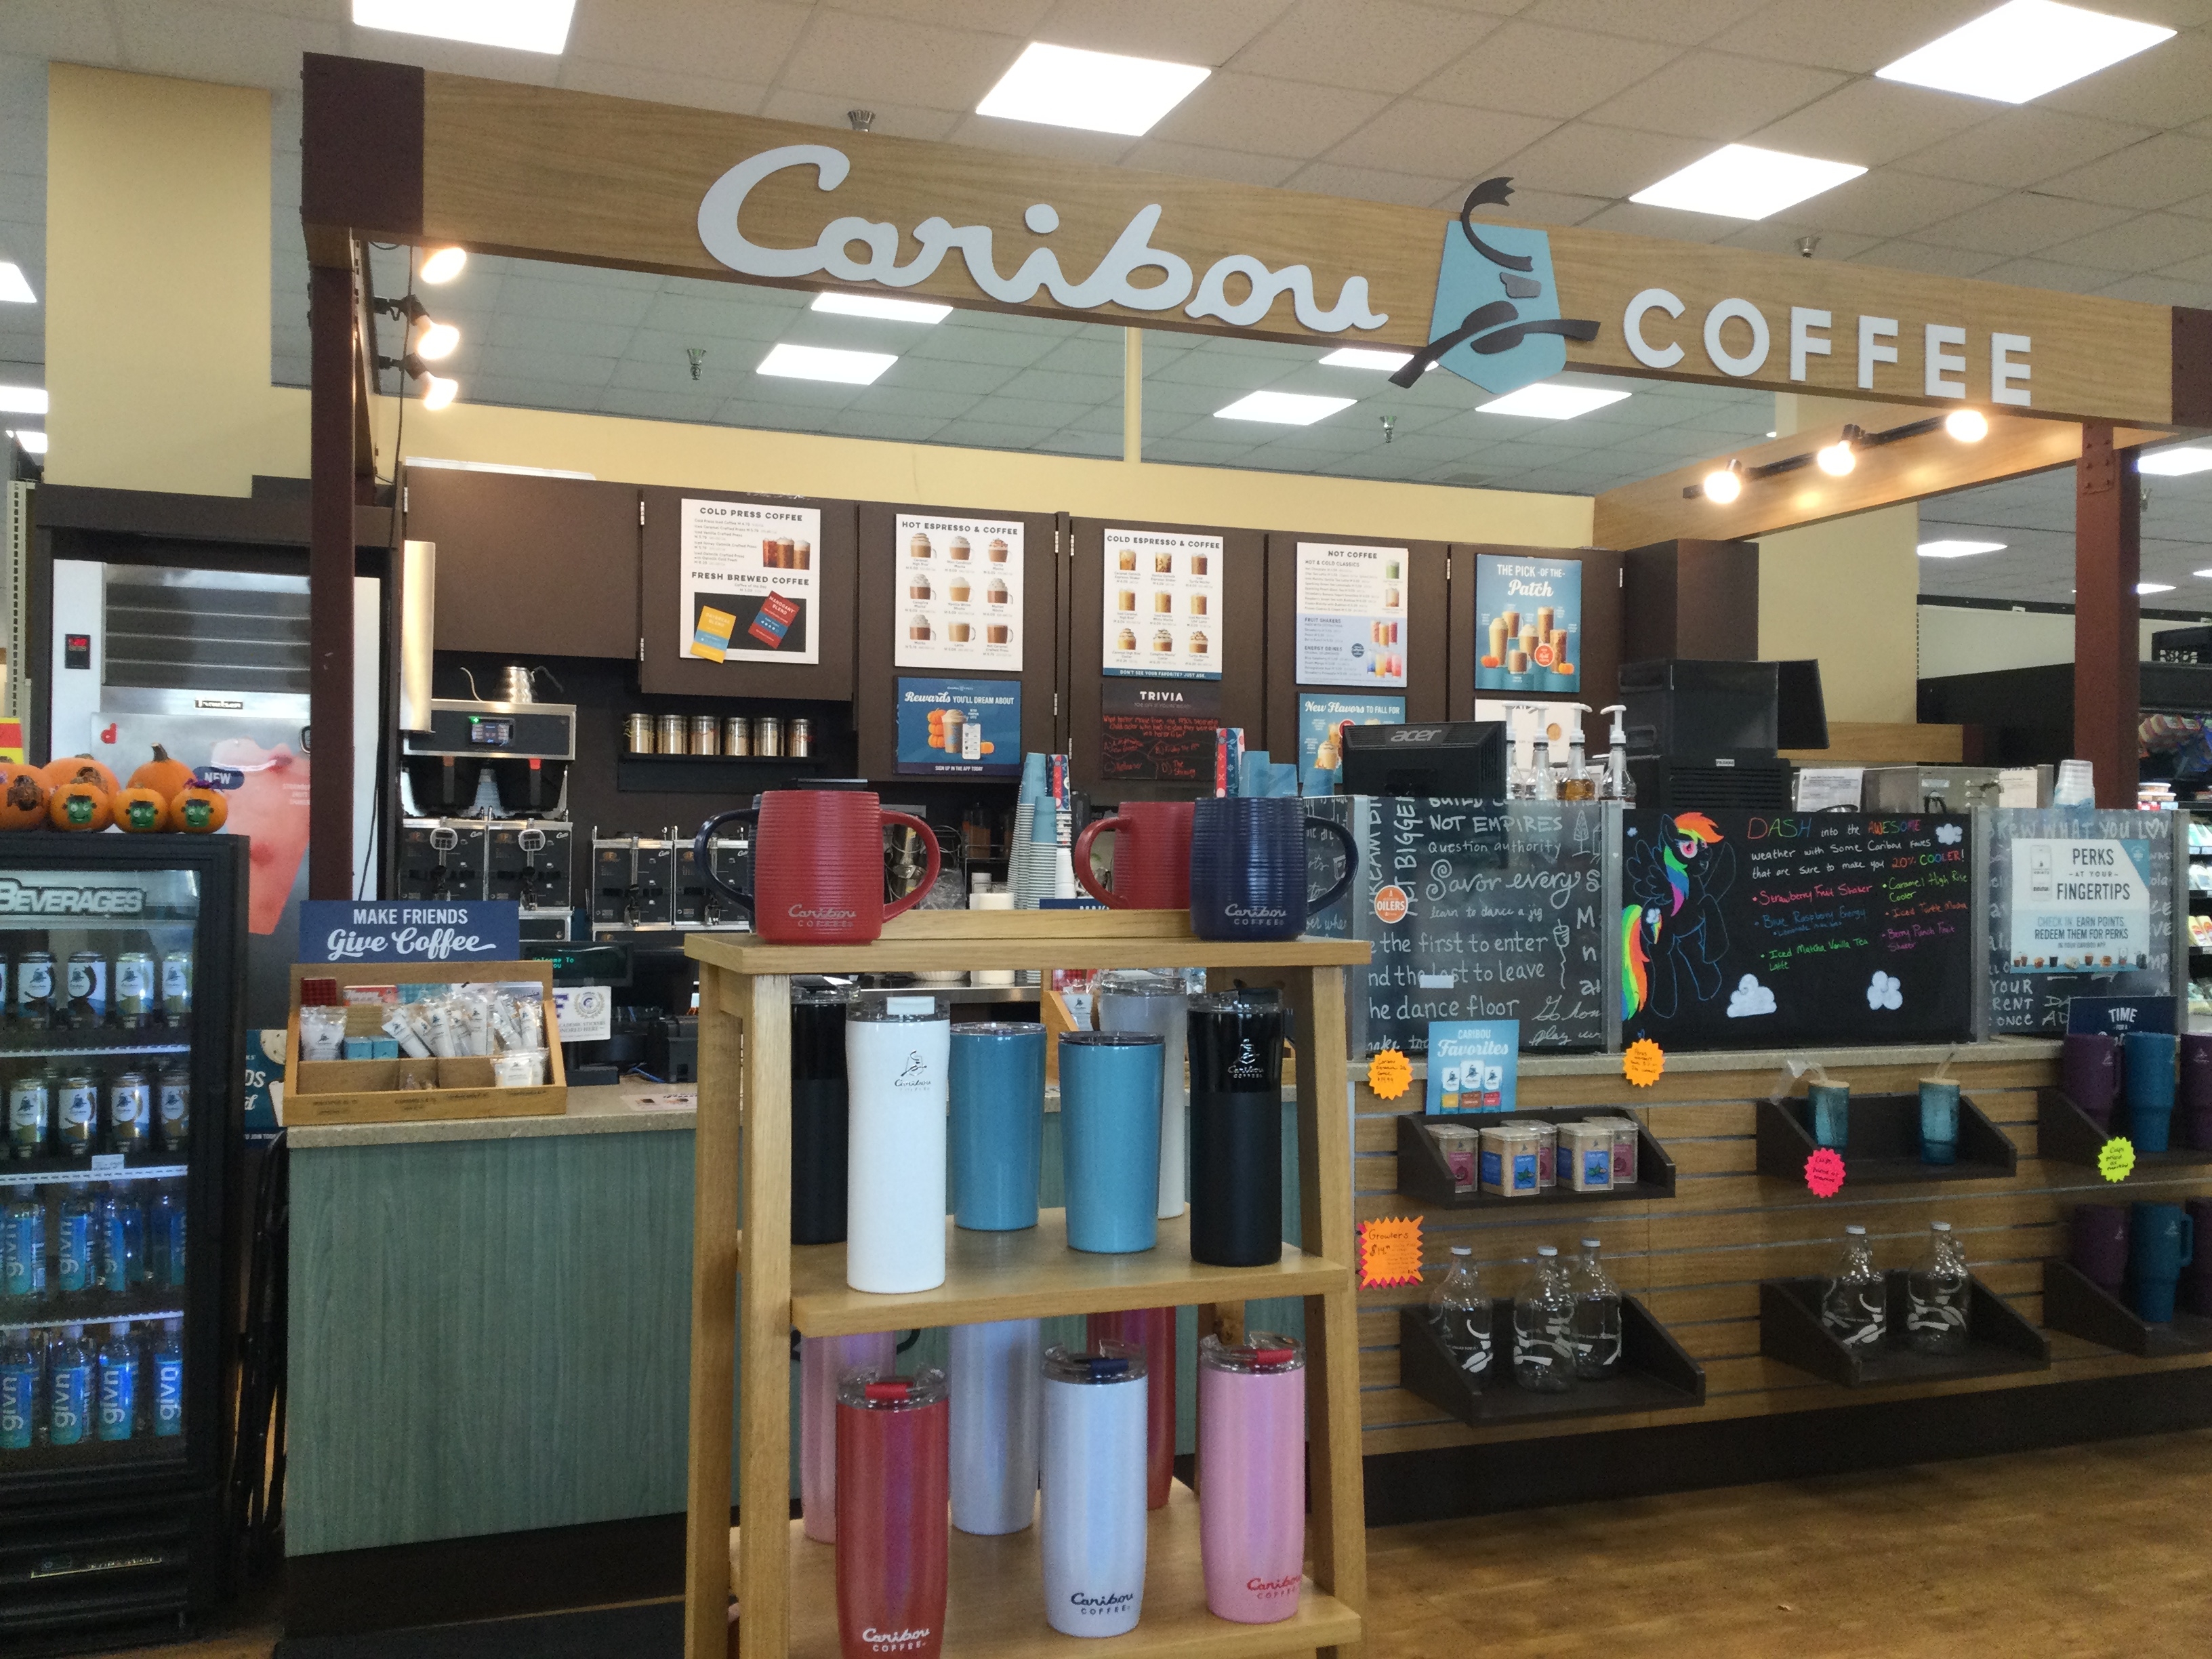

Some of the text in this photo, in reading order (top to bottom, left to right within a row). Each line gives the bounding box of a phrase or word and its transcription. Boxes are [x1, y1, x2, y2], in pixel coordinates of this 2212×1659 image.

[698, 144, 2031, 407] Caribou COFFEE
[700, 508, 802, 521] COLD PRESS COFFEE
[925, 523, 970, 532] ESPRESSO
[1134, 537, 1176, 546] ESPRESSO
[1188, 541, 1220, 549] COFFEE
[1497, 565, 1535, 577] THE PICK
[728, 575, 768, 583] BREWED
[773, 577, 809, 586] COFFEE
[1507, 579, 1553, 596] Patch
[772, 605, 787, 615] BLEND
[905, 691, 950, 702] Rewards
[1140, 691, 1183, 701] TRIVIA
[1305, 701, 1326, 712] New
[1328, 701, 1364, 713] Flavors
[1391, 729, 1442, 742] acer
[1430, 815, 1563, 832] NOT EMPIRES
[1747, 817, 1921, 839] DASH into the AWESOME
[1429, 840, 1561, 859] Question authority
[1750, 840, 1902, 861] weather with Caribou
[2073, 848, 2114, 865] PERKS
[1753, 850, 1965, 879] that are sure to make you 20% COOLER!
[1426, 859, 1580, 909] Savor every
[1889, 877, 1925, 889] Caramel
[1929, 872, 1949, 886] High
[1759, 890, 1813, 905] Strawberry
[1814, 884, 1835, 897] Fruit
[2057, 883, 2130, 900] FINGERTIPS
[788, 905, 857, 918] Caribou
[1225, 903, 1286, 916] Caribou
[1376, 902, 1405, 911] OILERS
[1430, 906, 1458, 918] learn
[1467, 906, 1476, 918] to
[1481, 906, 1514, 917] dance
[1528, 904, 1542, 922] jig
[354, 909, 468, 924] MAKE FRIENDS
[2038, 917, 2062, 926] CHECK
[2076, 917, 2095, 927] EARN
[1380, 931, 1549, 953] the first to enter
[2035, 928, 2129, 939] REDEEM THEM FOR PERKS
[327, 927, 496, 961] Give Coffee
[1769, 947, 1793, 960] Iced
[1853, 938, 1868, 946] Tea
[1473, 963, 1493, 981] to
[1498, 960, 1545, 982] leave
[1990, 978, 2033, 995] YOUR
[1396, 995, 1519, 1020] dance floor
[2108, 1007, 2138, 1023] TIME
[1458, 1029, 1491, 1039] CARIBOU
[1437, 1039, 1509, 1057] Favorites
[1369, 1229, 1408, 1240] Growlers
[55, 1374, 76, 1428] givn
[101, 1370, 125, 1425] givn
[159, 1367, 179, 1420] givn
[2, 1376, 24, 1431] givn
[1247, 1575, 1302, 1591] Caribou
[1071, 1593, 1133, 1606] Caribou
[1081, 1605, 1127, 1616] COFFEE
[863, 1628, 930, 1642] Caribou
